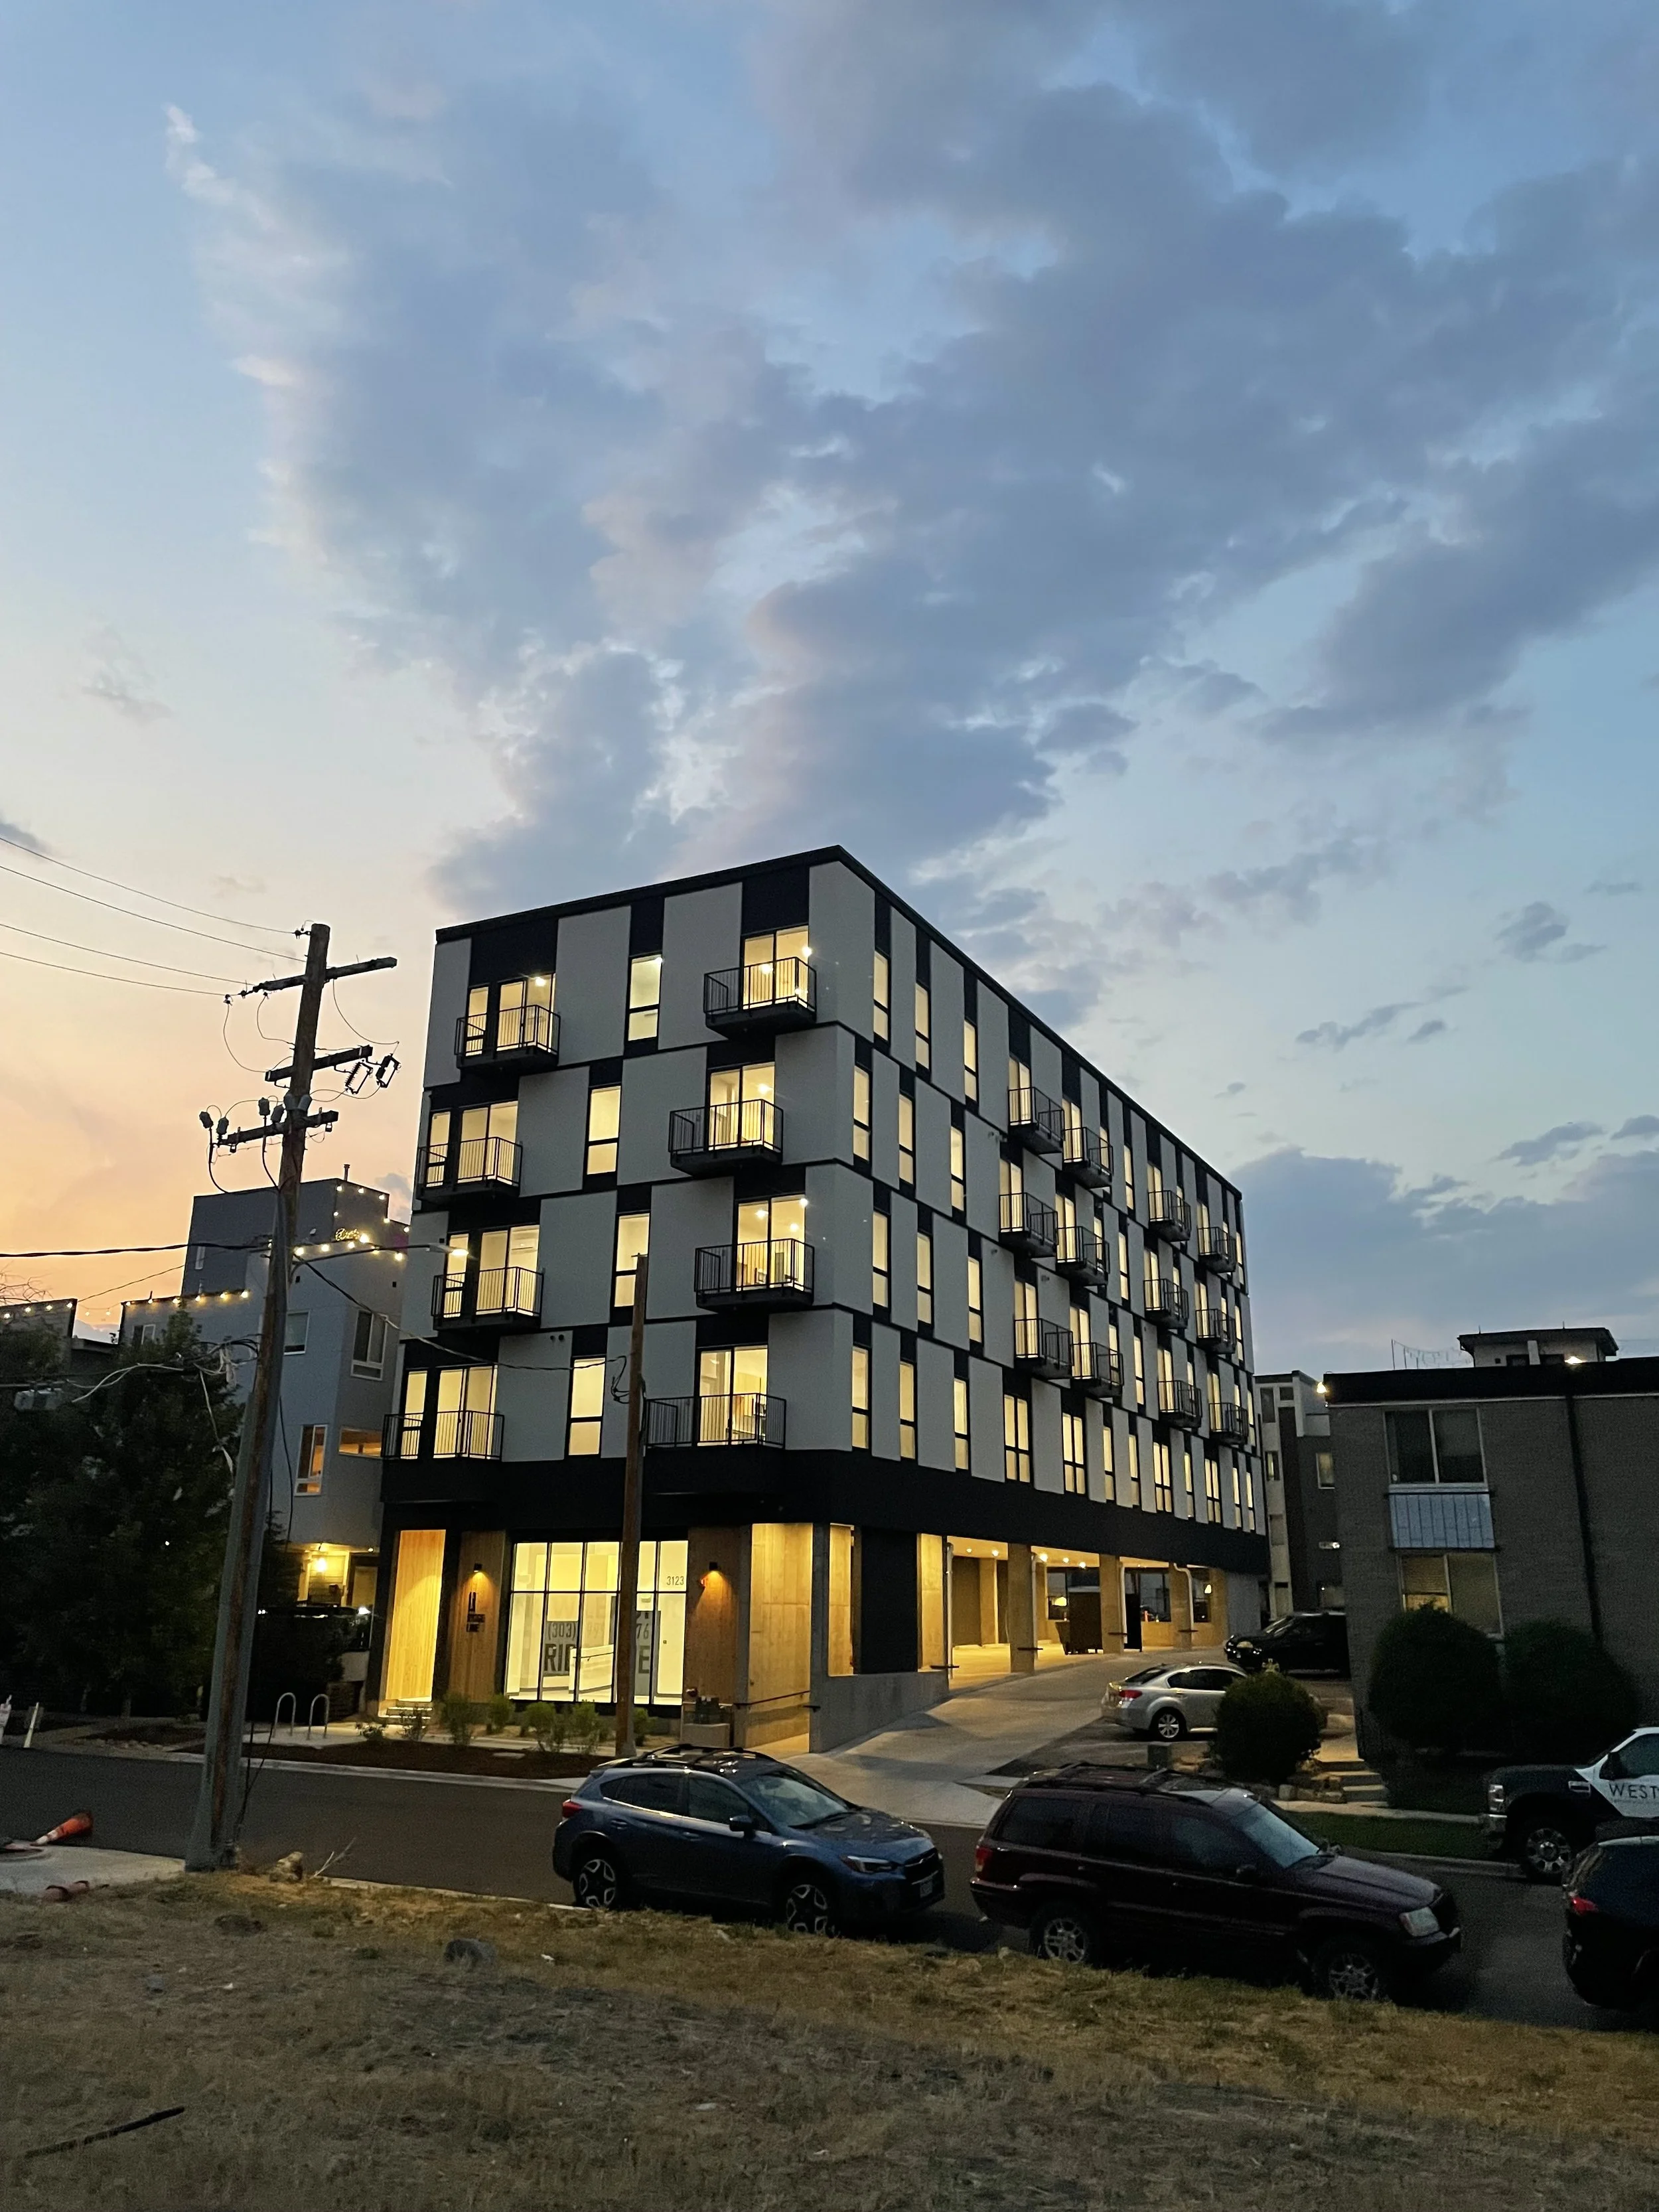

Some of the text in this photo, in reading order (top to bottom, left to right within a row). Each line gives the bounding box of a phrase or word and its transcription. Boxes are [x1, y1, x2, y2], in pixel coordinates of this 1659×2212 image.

[666, 1576, 684, 1585] 3123
[547, 1622, 576, 1641] (303)
[1609, 1782, 1659, 1800] WEST
